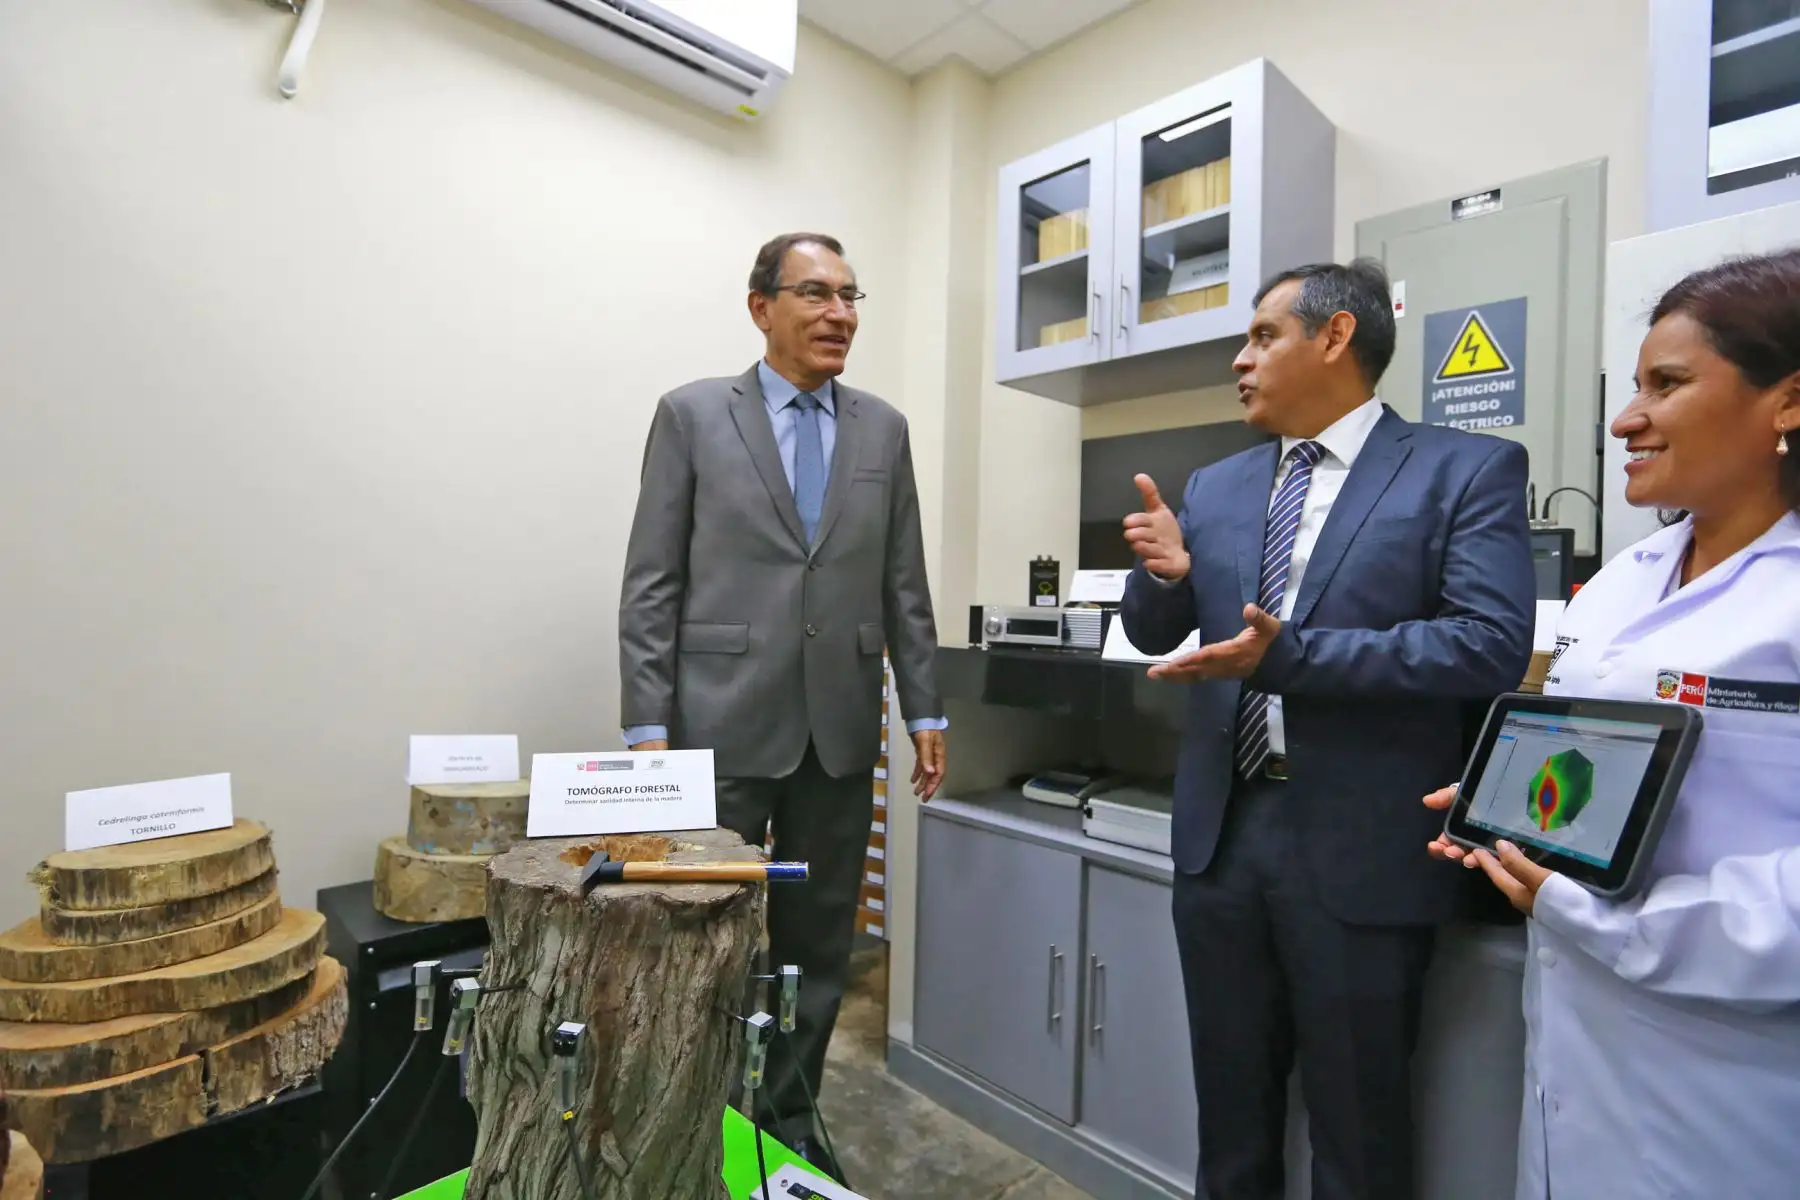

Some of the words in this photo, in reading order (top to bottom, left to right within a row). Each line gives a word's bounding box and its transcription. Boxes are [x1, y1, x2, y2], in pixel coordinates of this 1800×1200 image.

[1432, 379, 1516, 403] ¡ATENCIÓN!
[1444, 398, 1501, 416] RIESGO
[1432, 415, 1514, 431] ÉCTRICO
[1680, 683, 1704, 696] PERÚ
[1708, 687, 1757, 699] Ministerio
[1707, 697, 1717, 705] de
[1719, 698, 1765, 709] Agricultura
[566, 785, 632, 796] TOMÓGRAFO
[635, 784, 681, 794] FORESTAL
[98, 814, 148, 826] Cedrelinga
[130, 823, 176, 835] TORNILLO
